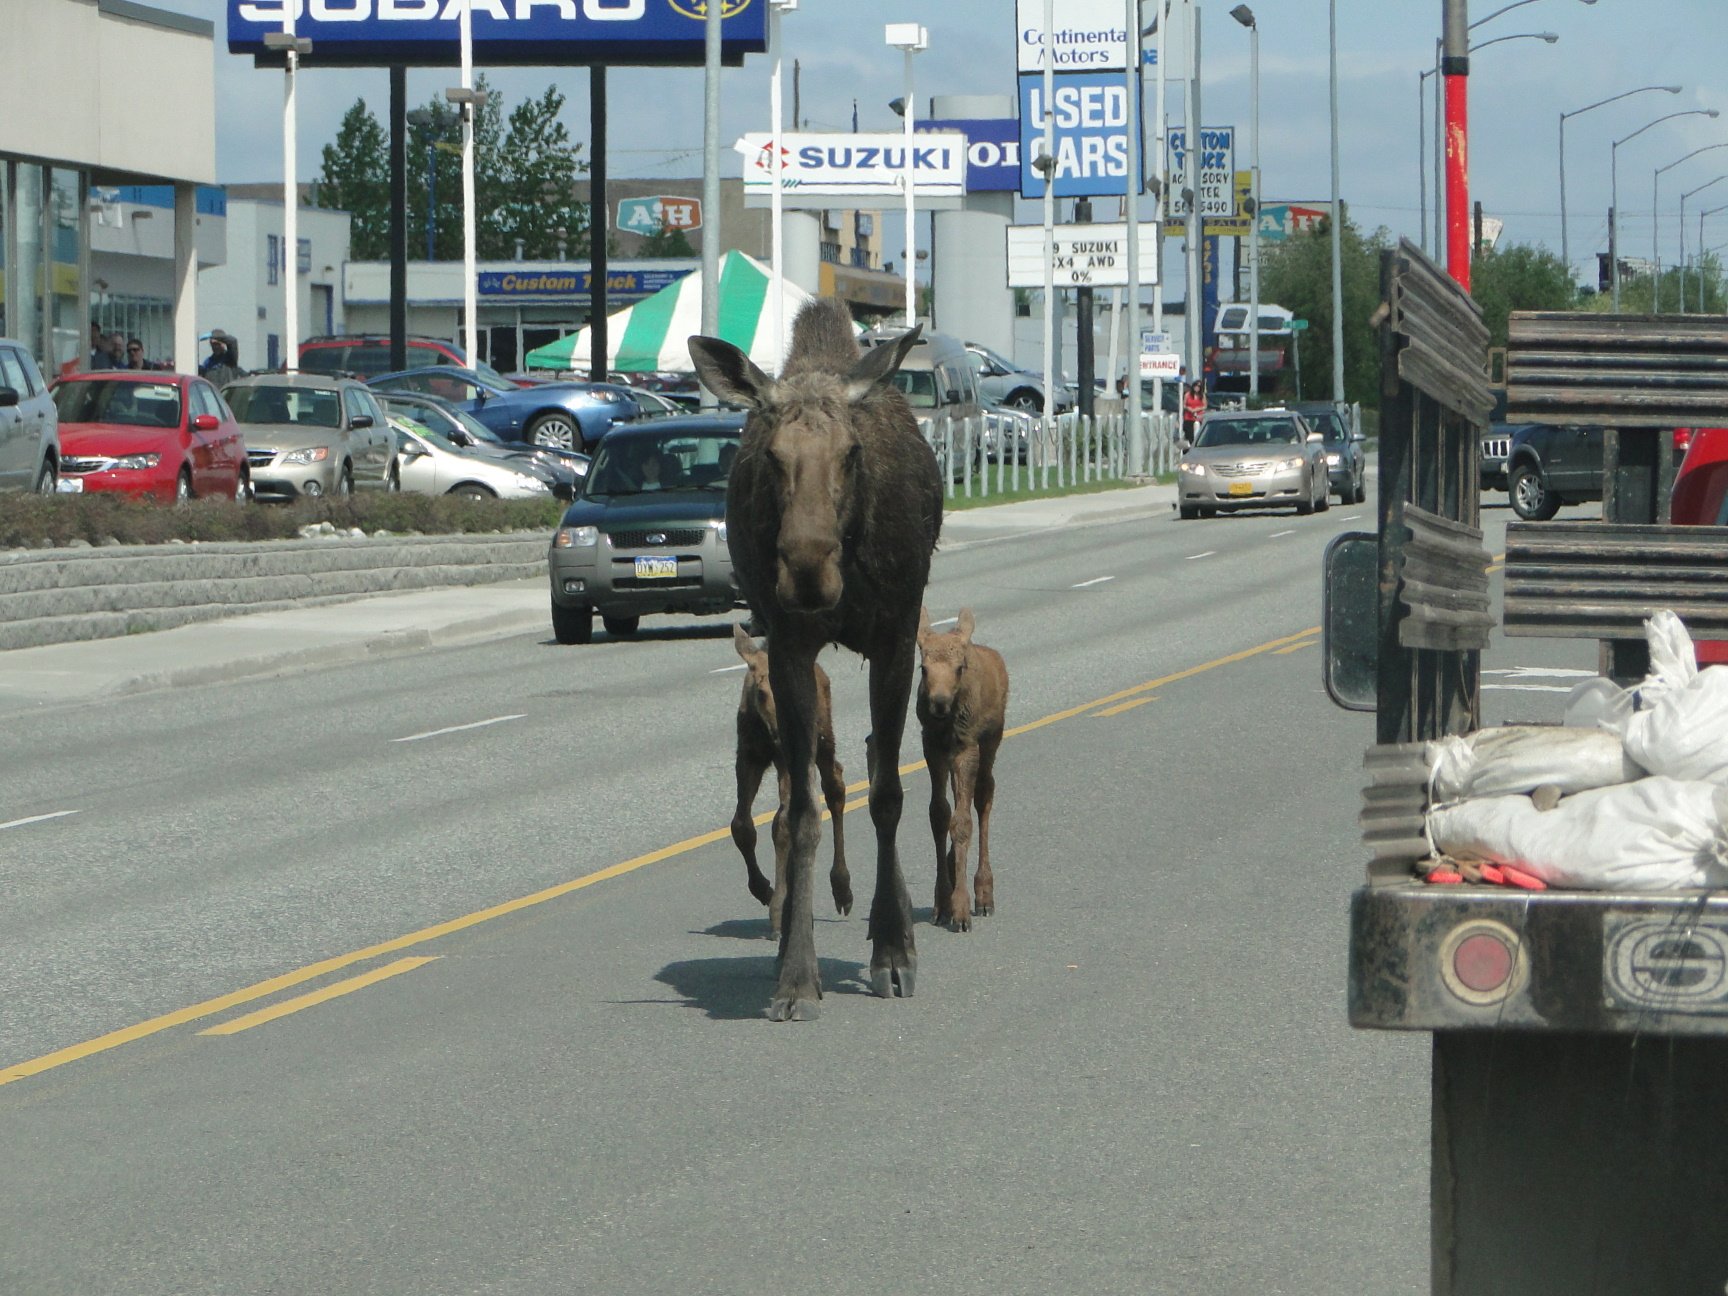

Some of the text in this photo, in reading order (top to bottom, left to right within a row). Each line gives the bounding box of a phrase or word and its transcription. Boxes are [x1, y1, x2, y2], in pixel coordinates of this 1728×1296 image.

[1023, 27, 1128, 45] Continenta
[1037, 47, 1109, 64] Motors
[1031, 86, 1127, 129] USED
[1170, 131, 1230, 150] CTOM
[799, 147, 950, 170] SUZUKI
[1031, 135, 1127, 179] CARS
[1174, 151, 1226, 170] TCK
[1072, 241, 1119, 254] SUZUKI
[1087, 256, 1115, 268] AWD
[502, 274, 576, 290] Custom
[582, 273, 636, 290] Tuck
[1071, 271, 1092, 283] 0%
